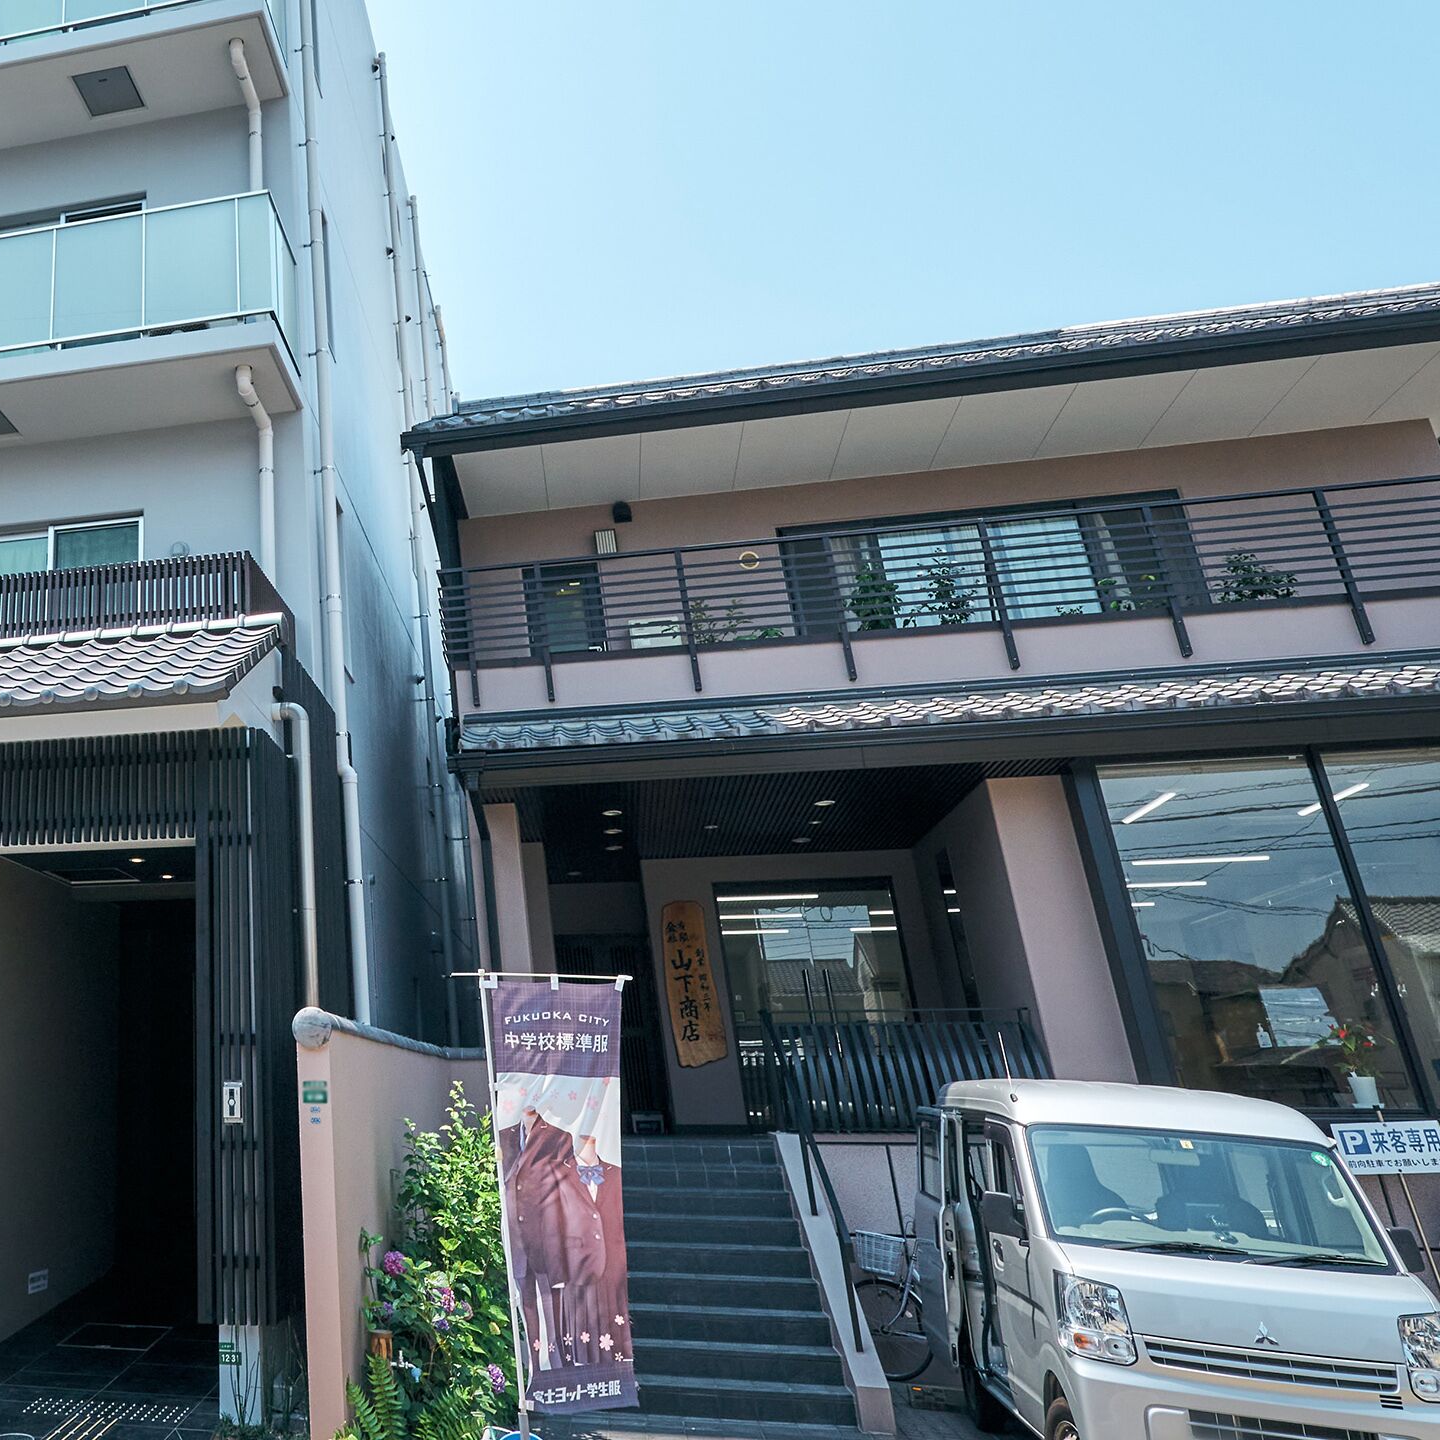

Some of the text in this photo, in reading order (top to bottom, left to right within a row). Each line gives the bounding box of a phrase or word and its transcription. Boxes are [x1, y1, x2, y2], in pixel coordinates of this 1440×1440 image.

[671, 949, 700, 1042] 山下商店
[504, 1011, 610, 1027] FUKUOKA CITY
[504, 1031, 609, 1053] 中学校標準服
[1342, 1131, 1364, 1154] P
[1370, 1128, 1440, 1155] 来客専用
[1348, 1158, 1440, 1169] 前向駐車でお願いしま
